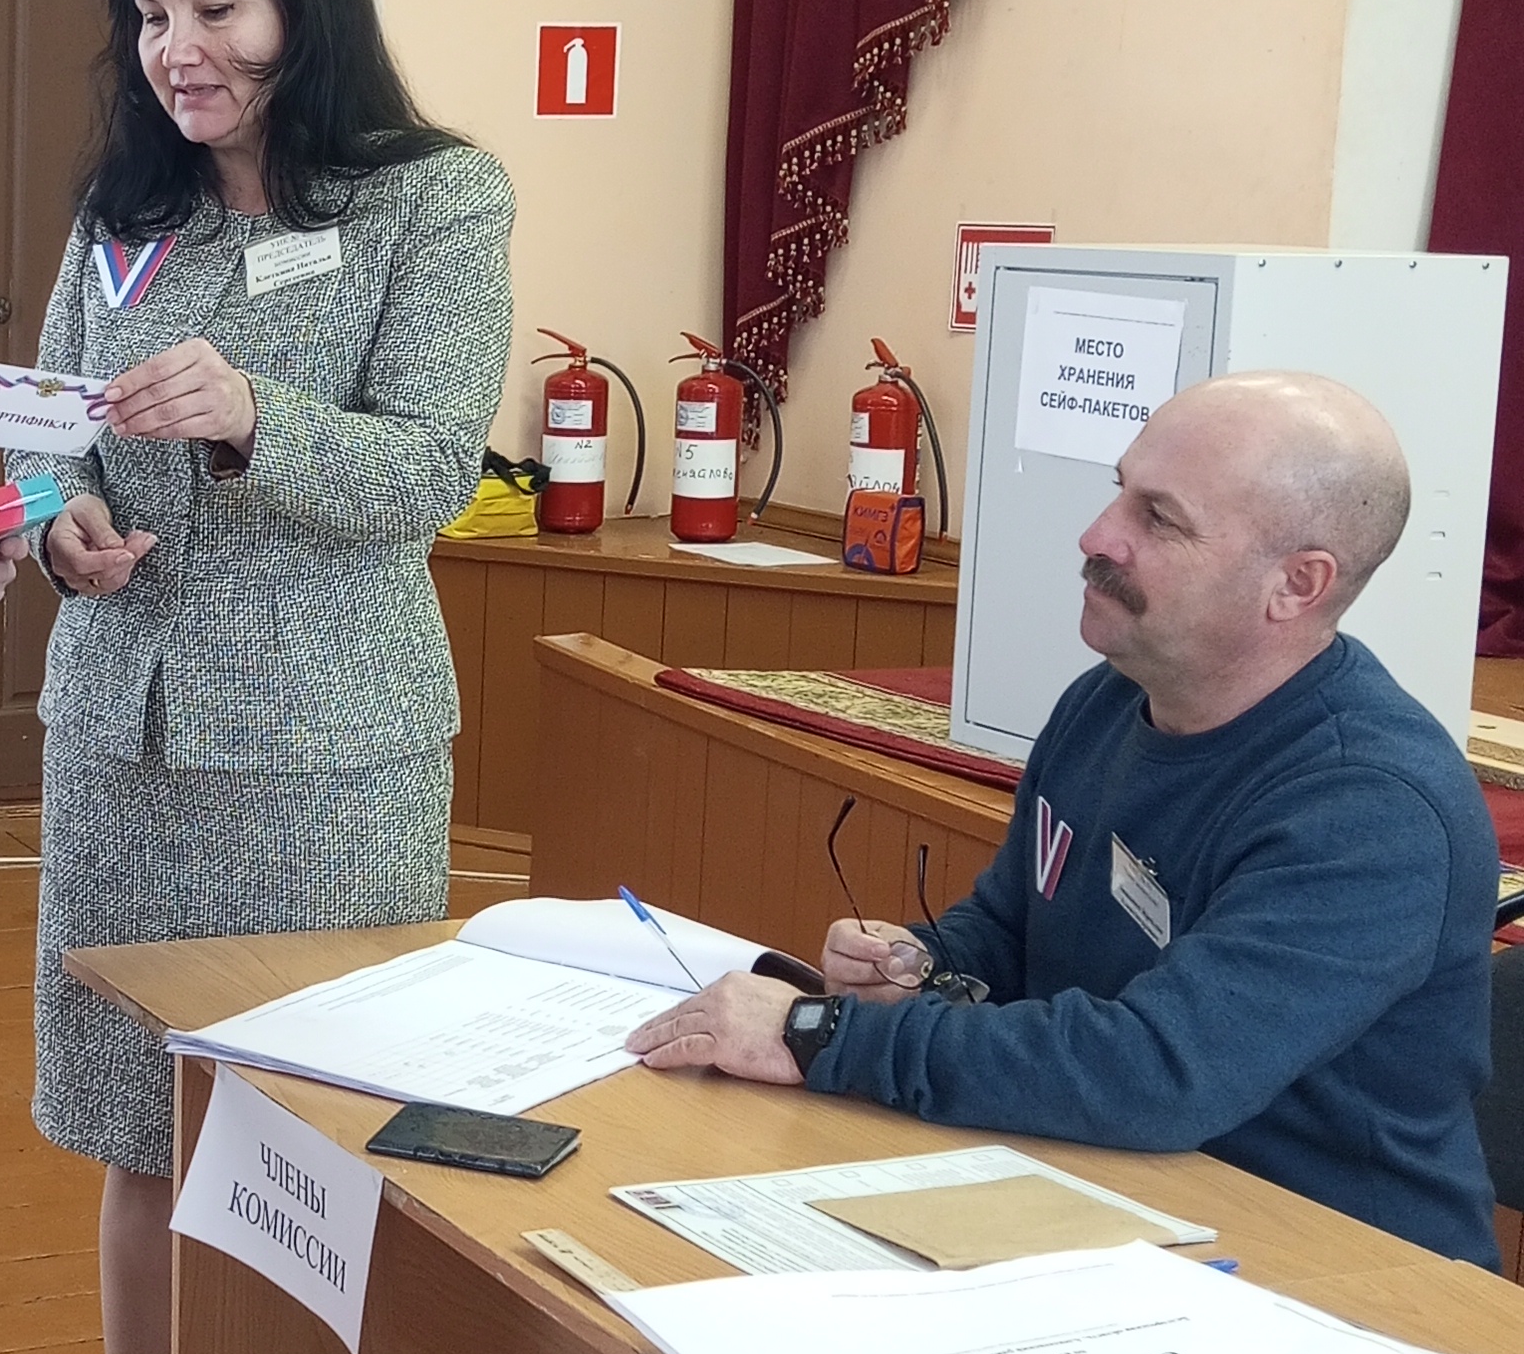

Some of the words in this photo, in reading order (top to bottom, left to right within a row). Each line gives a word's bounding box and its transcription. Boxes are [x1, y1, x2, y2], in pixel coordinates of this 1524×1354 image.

[257, 235, 326, 263] ПРЕДСЕДАТЕЛЬ
[1074, 337, 1124, 359] МЕСТО
[1057, 364, 1135, 391] ХРАНЕНИЯ
[1040, 390, 1150, 423] СЕЙФ-ПАКЕТОВ
[853, 504, 889, 522] КИМГЗ
[259, 1141, 328, 1220] ЧЛЕНЫ
[228, 1181, 348, 1294] КОМИССИИ
